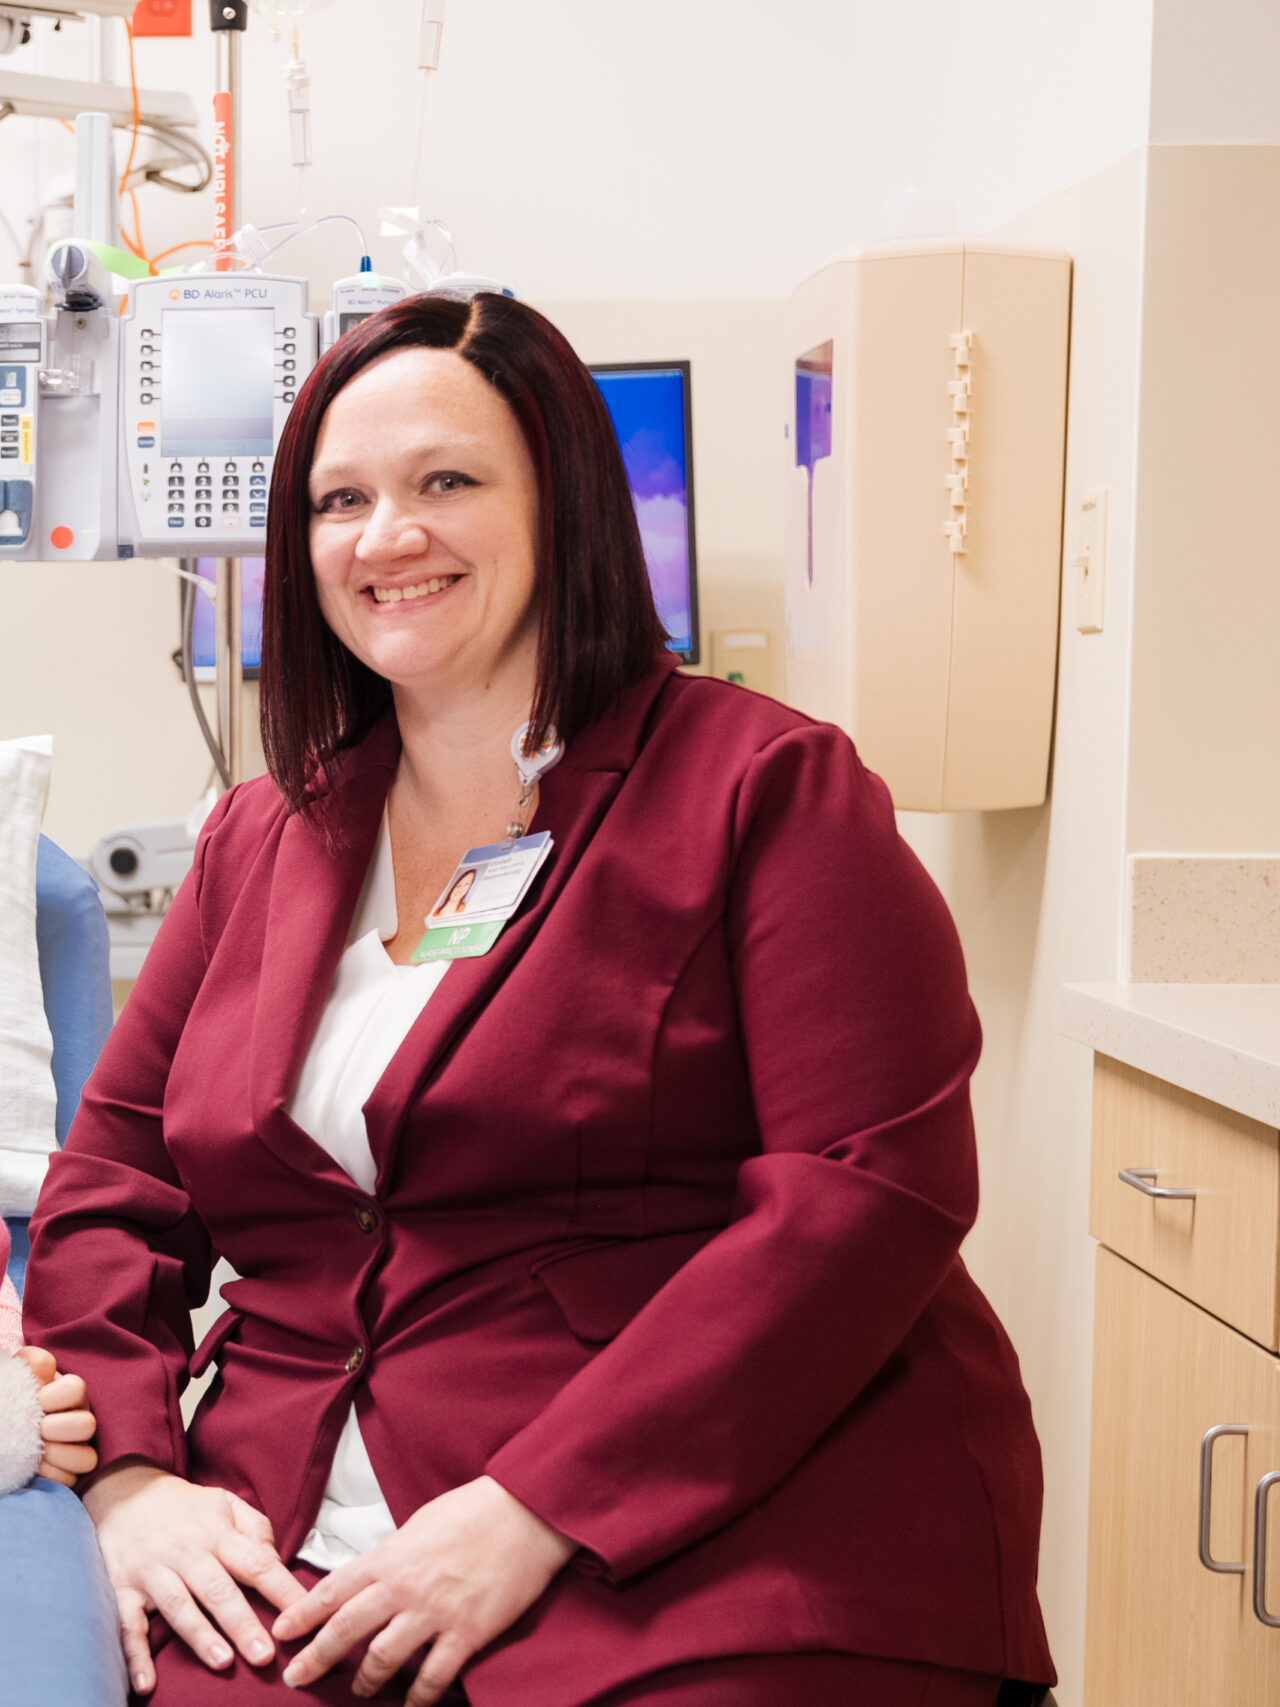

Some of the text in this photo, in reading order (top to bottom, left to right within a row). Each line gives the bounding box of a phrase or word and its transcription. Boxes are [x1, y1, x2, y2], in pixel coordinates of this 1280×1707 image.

[183, 289, 200, 299] BD
[244, 288, 267, 299] PCU
[447, 927, 471, 945] NP
